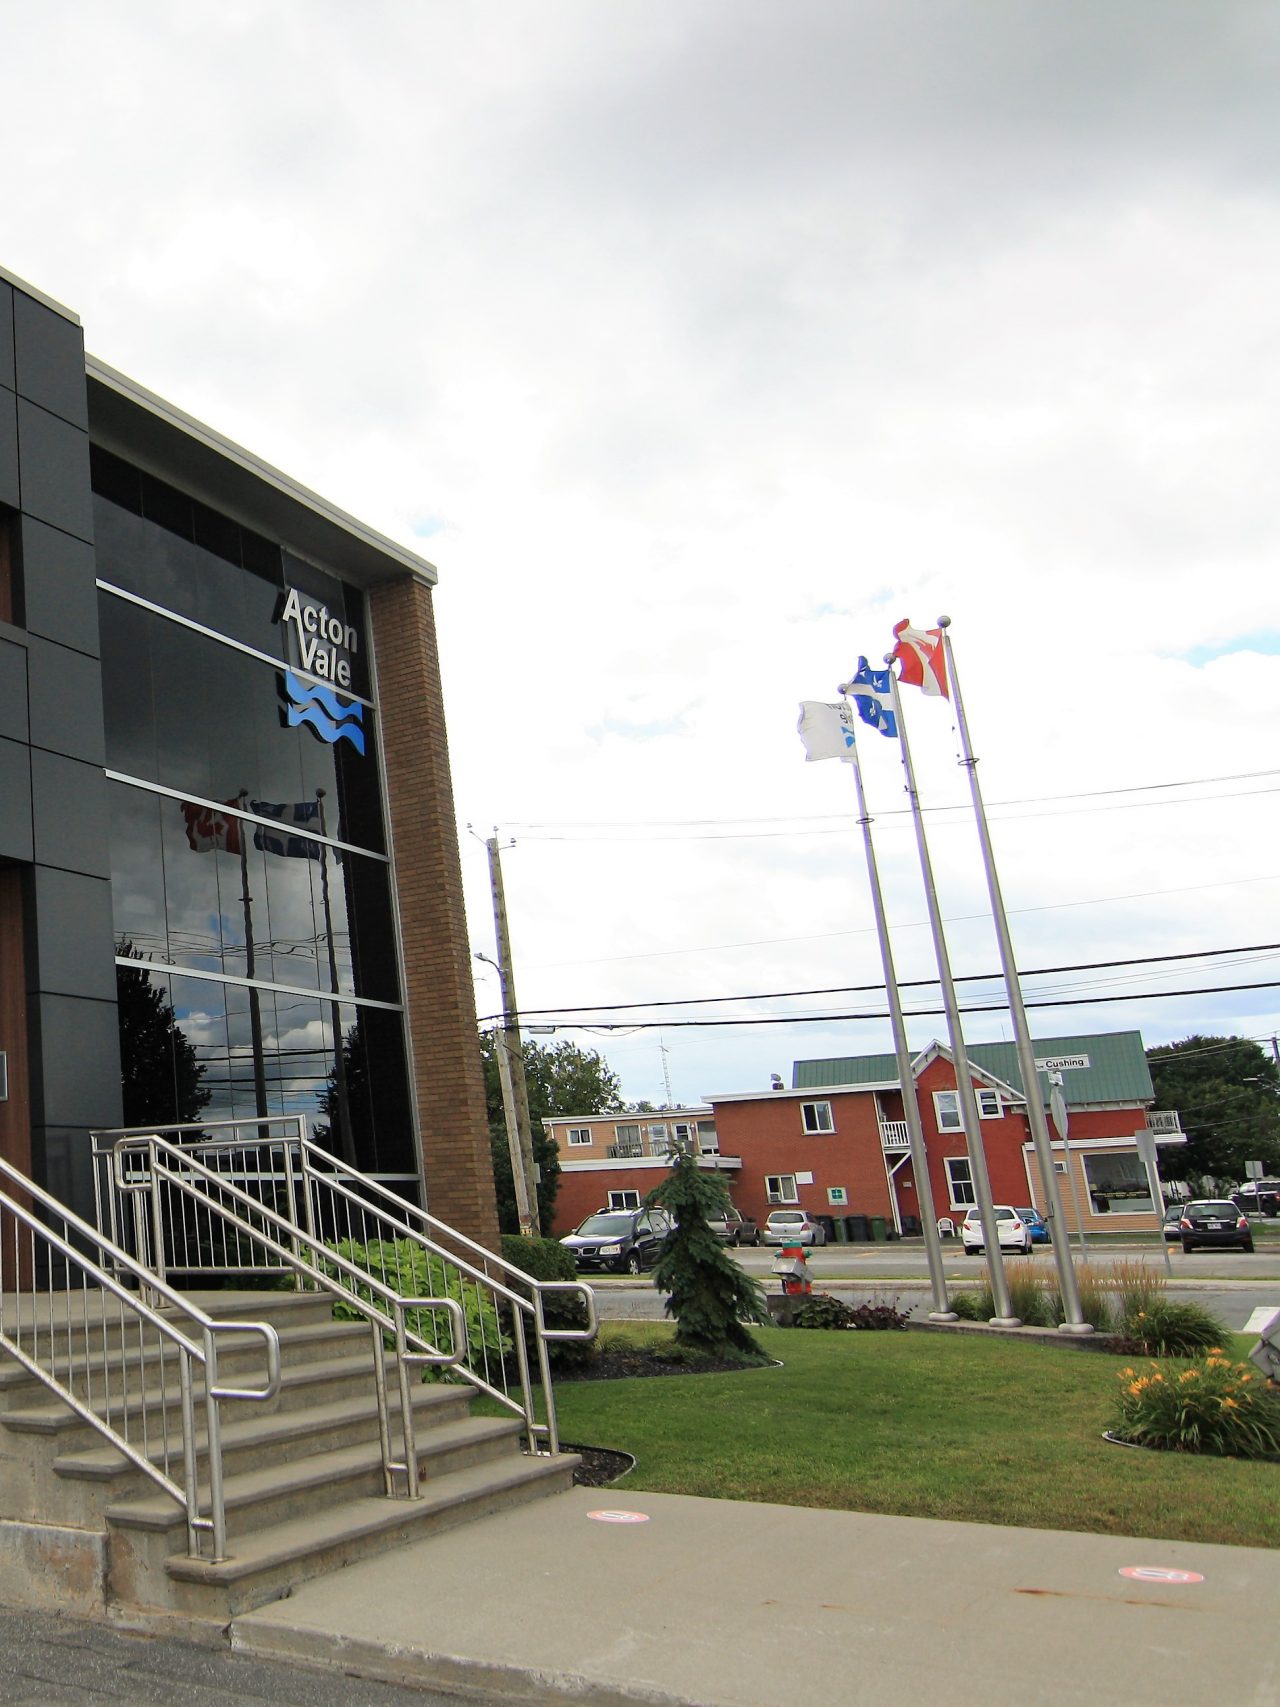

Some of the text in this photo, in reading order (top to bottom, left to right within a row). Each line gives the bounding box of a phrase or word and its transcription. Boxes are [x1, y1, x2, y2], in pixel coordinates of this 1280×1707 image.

[282, 588, 358, 654] Acton
[297, 637, 352, 688] Vale
[1045, 1059, 1084, 1068] Cushing
